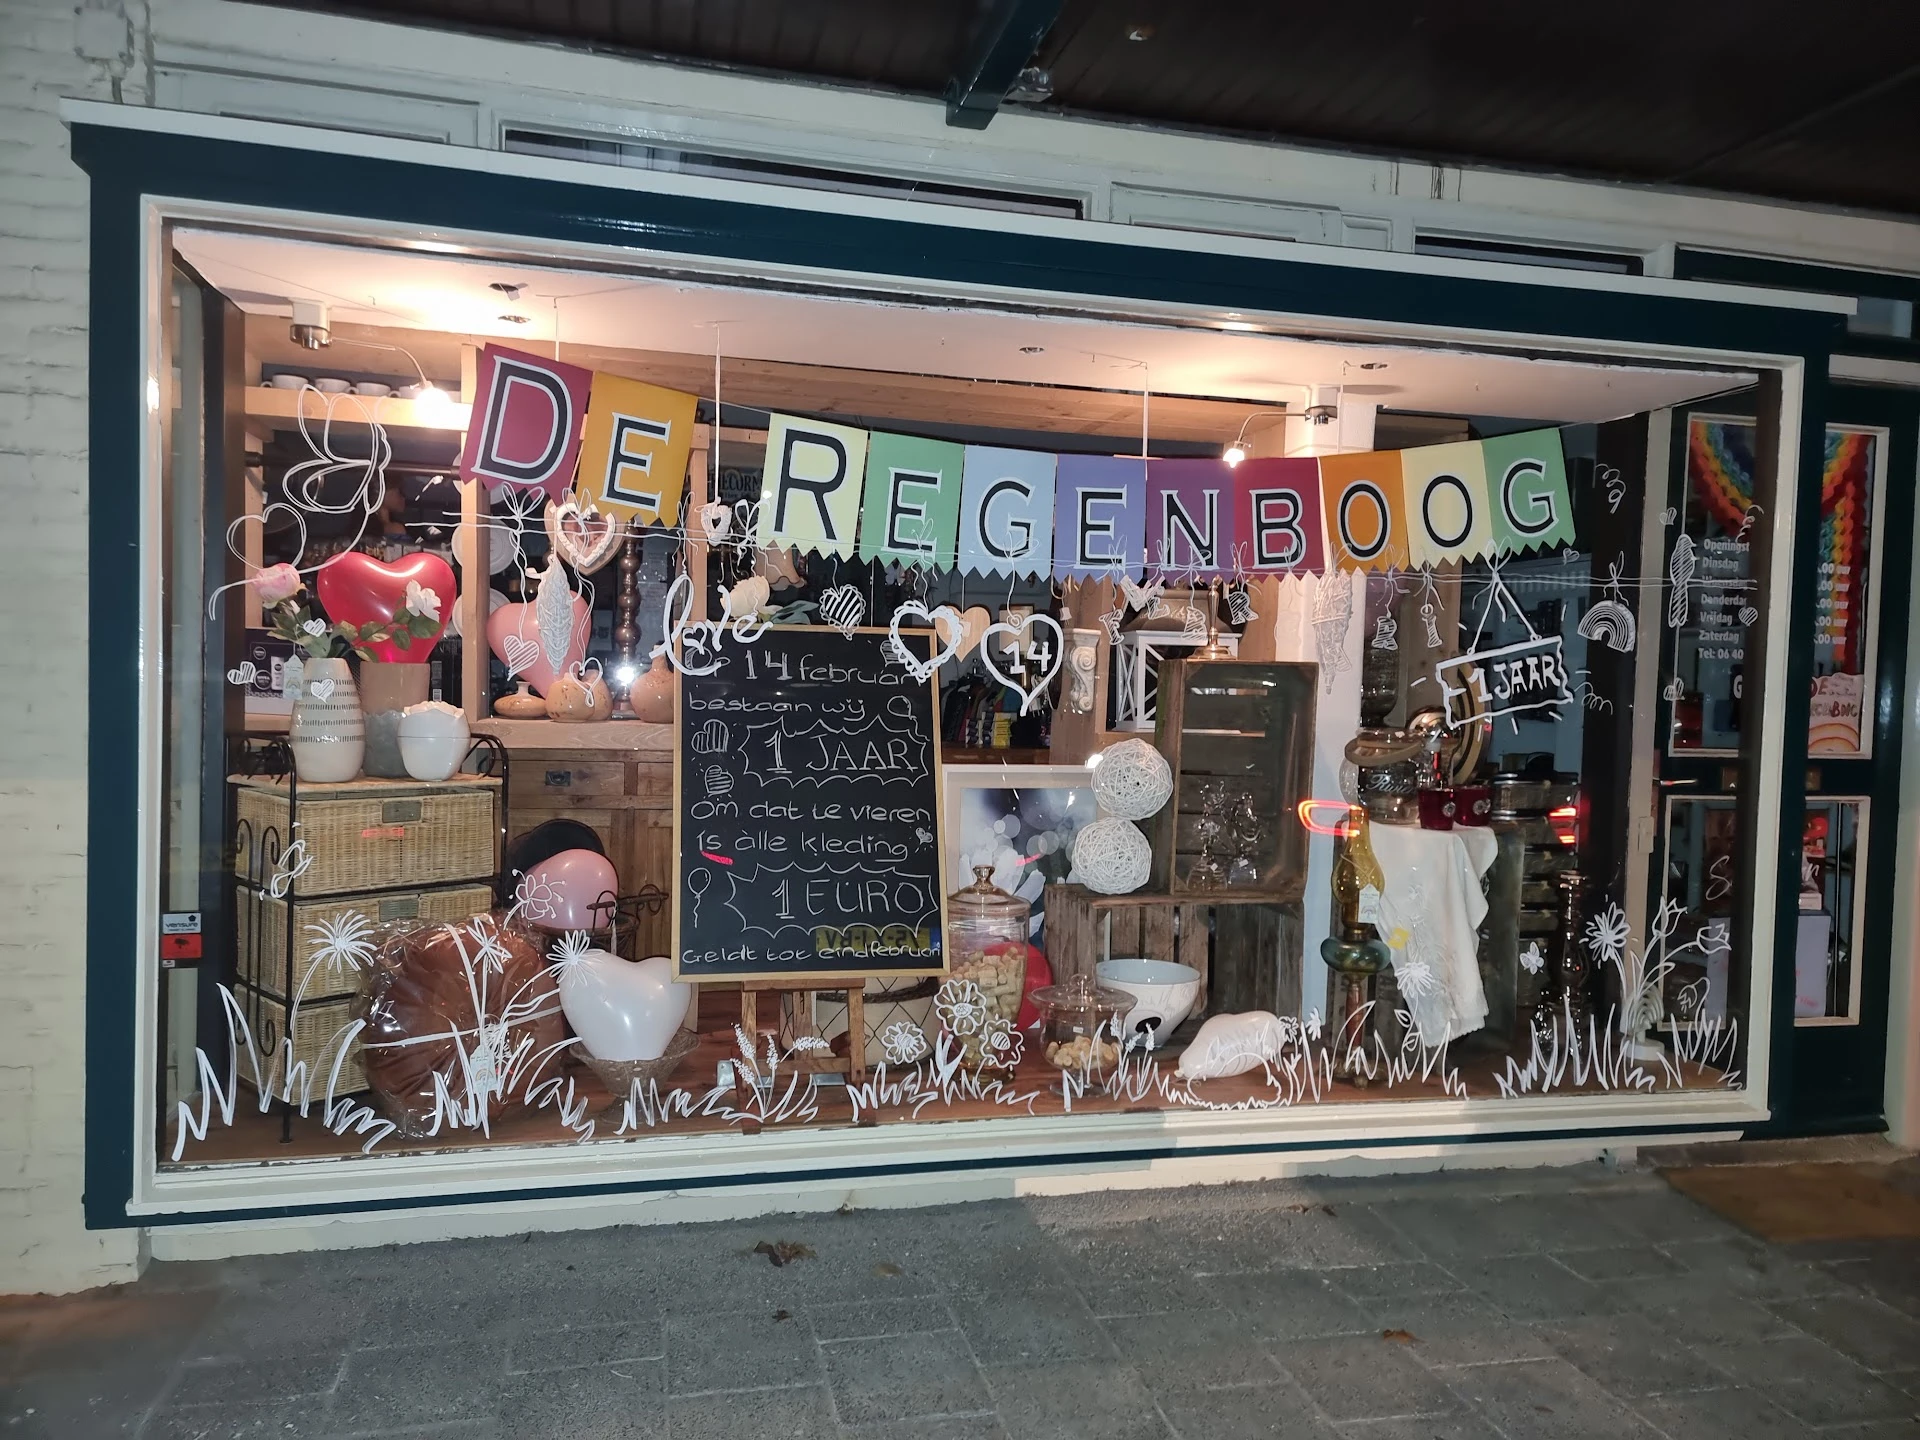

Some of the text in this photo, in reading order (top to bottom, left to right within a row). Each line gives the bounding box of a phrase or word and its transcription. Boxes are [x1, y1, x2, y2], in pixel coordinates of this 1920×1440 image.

[471, 354, 1559, 572] DE REGENBOOG
[1702, 557, 1738, 571] Dinsdag
[1700, 612, 1733, 626] Vrijdag
[1699, 630, 1739, 644] Zaterdag
[1003, 640, 1052, 675] 14
[1718, 649, 1729, 659] 06
[1732, 649, 1744, 659] 40
[745, 649, 793, 681] 14
[799, 654, 921, 687] februar
[1467, 655, 1561, 703] 1 JAAR
[689, 692, 812, 712] bestaan
[765, 730, 919, 774] 1 JAAR
[749, 801, 804, 820] dat
[812, 803, 842, 820] te
[850, 804, 931, 822] vieren
[801, 831, 909, 862] kleding
[772, 879, 925, 920] 1 EURO
[682, 948, 757, 964] Geldt
[766, 948, 805, 961] tot
